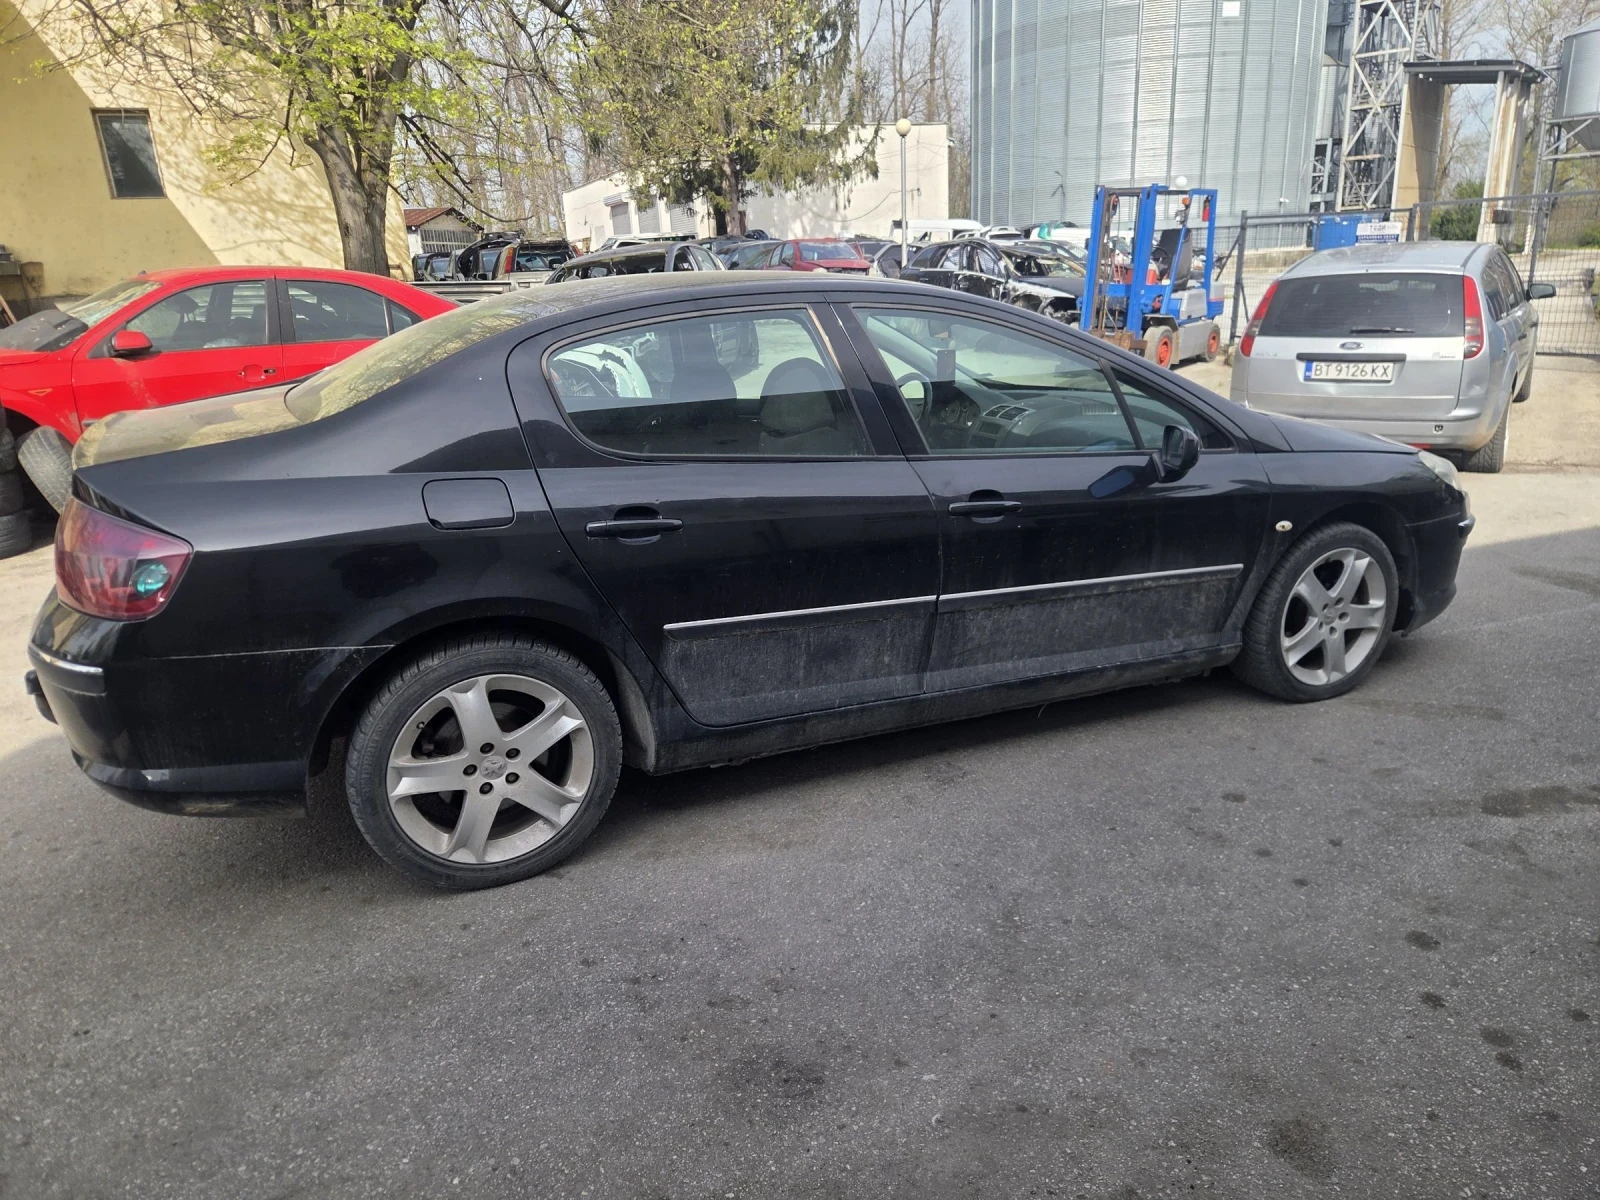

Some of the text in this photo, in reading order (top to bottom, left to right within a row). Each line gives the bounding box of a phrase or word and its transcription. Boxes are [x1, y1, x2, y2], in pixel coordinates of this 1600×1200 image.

[1314, 364, 1333, 376] BT
[1335, 364, 1368, 377] 9126
[1370, 365, 1390, 378] KX
